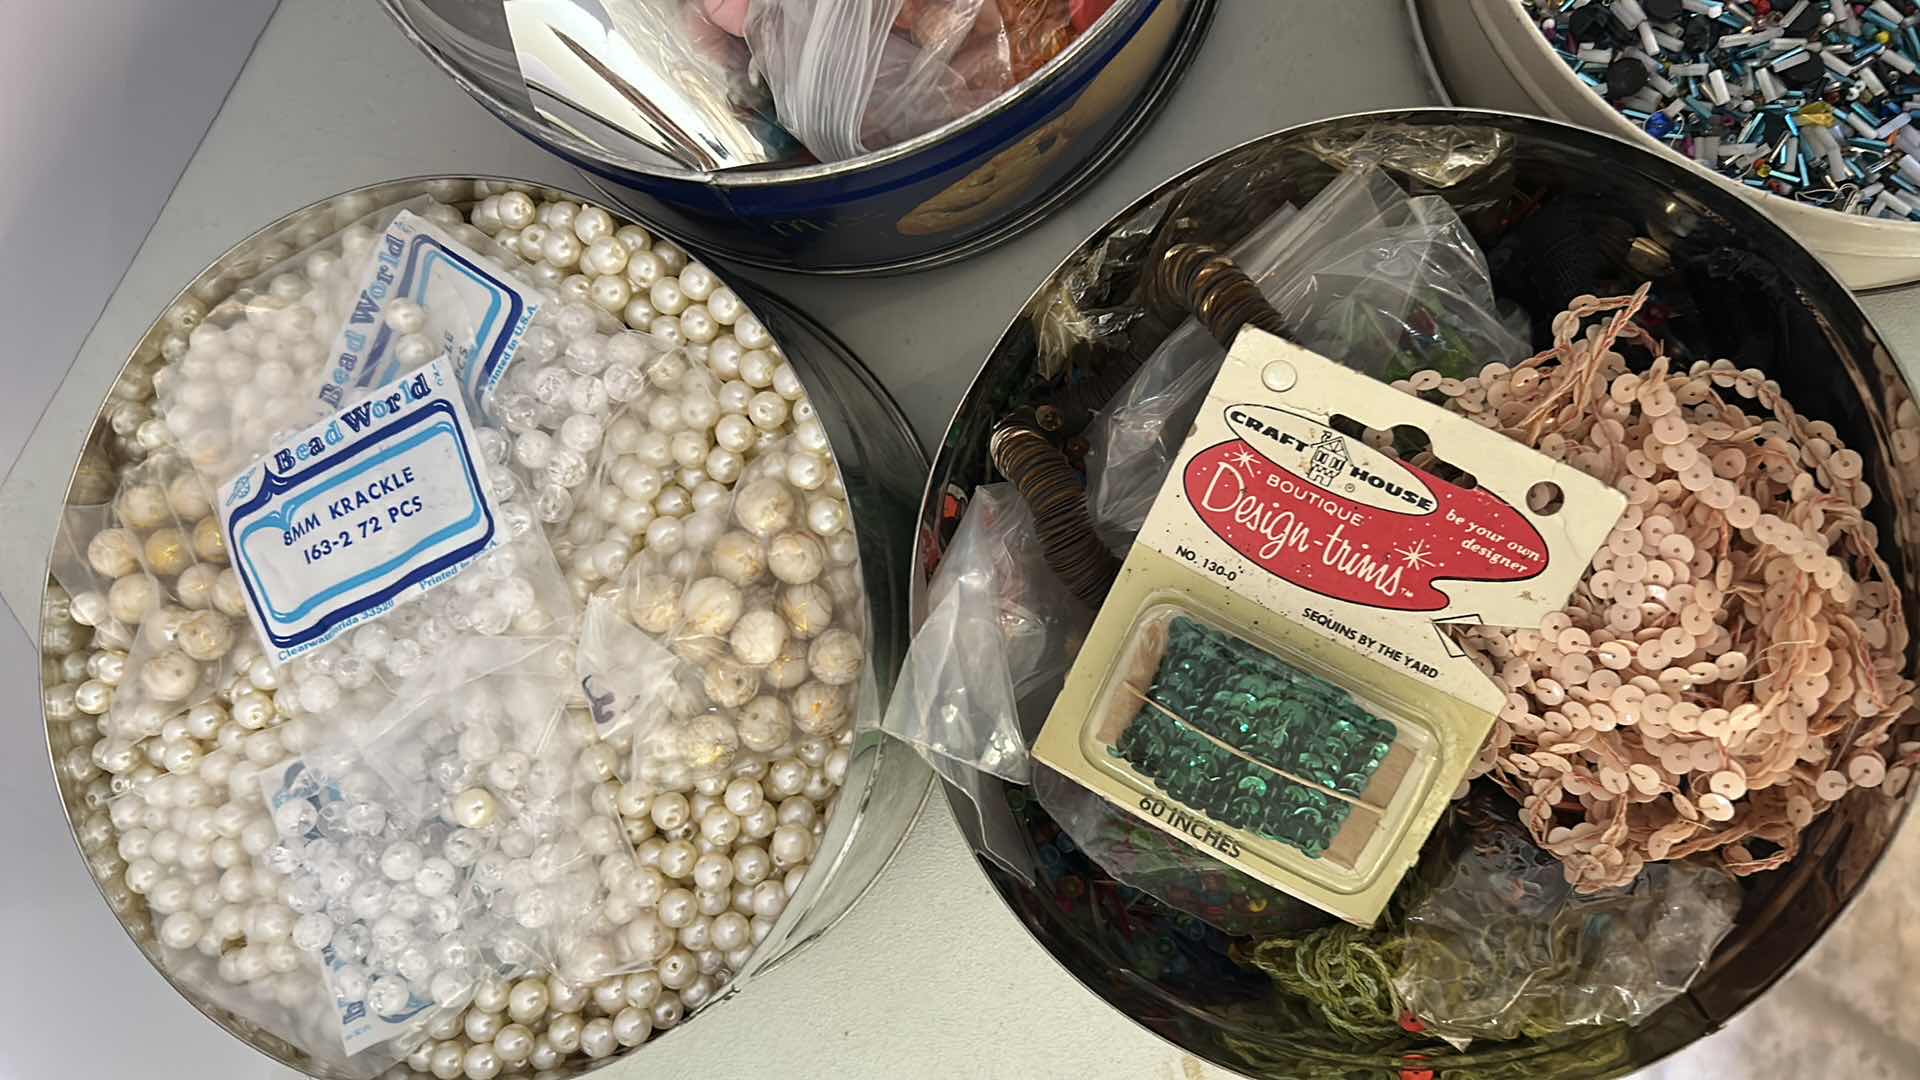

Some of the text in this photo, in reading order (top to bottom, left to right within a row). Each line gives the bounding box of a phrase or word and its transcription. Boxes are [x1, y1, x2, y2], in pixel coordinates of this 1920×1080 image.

[319, 331, 366, 408] Bead
[350, 233, 405, 324] World
[274, 373, 432, 474] Bead World
[1230, 410, 1434, 512] CRAFT HOUSE
[283, 466, 415, 546] 8MM KRACKLE
[304, 495, 423, 564] 163-2 72 PCS
[1266, 473, 1365, 527] BOUTIQUE
[1176, 545, 1237, 581] NO. 130-0
[1445, 509, 1540, 562] be your own
[1461, 539, 1528, 573] designer
[420, 566, 458, 590] Printed
[1302, 607, 1439, 679] SEQUINS BY THE YARD
[1140, 797, 1241, 858] 60 INCHES
